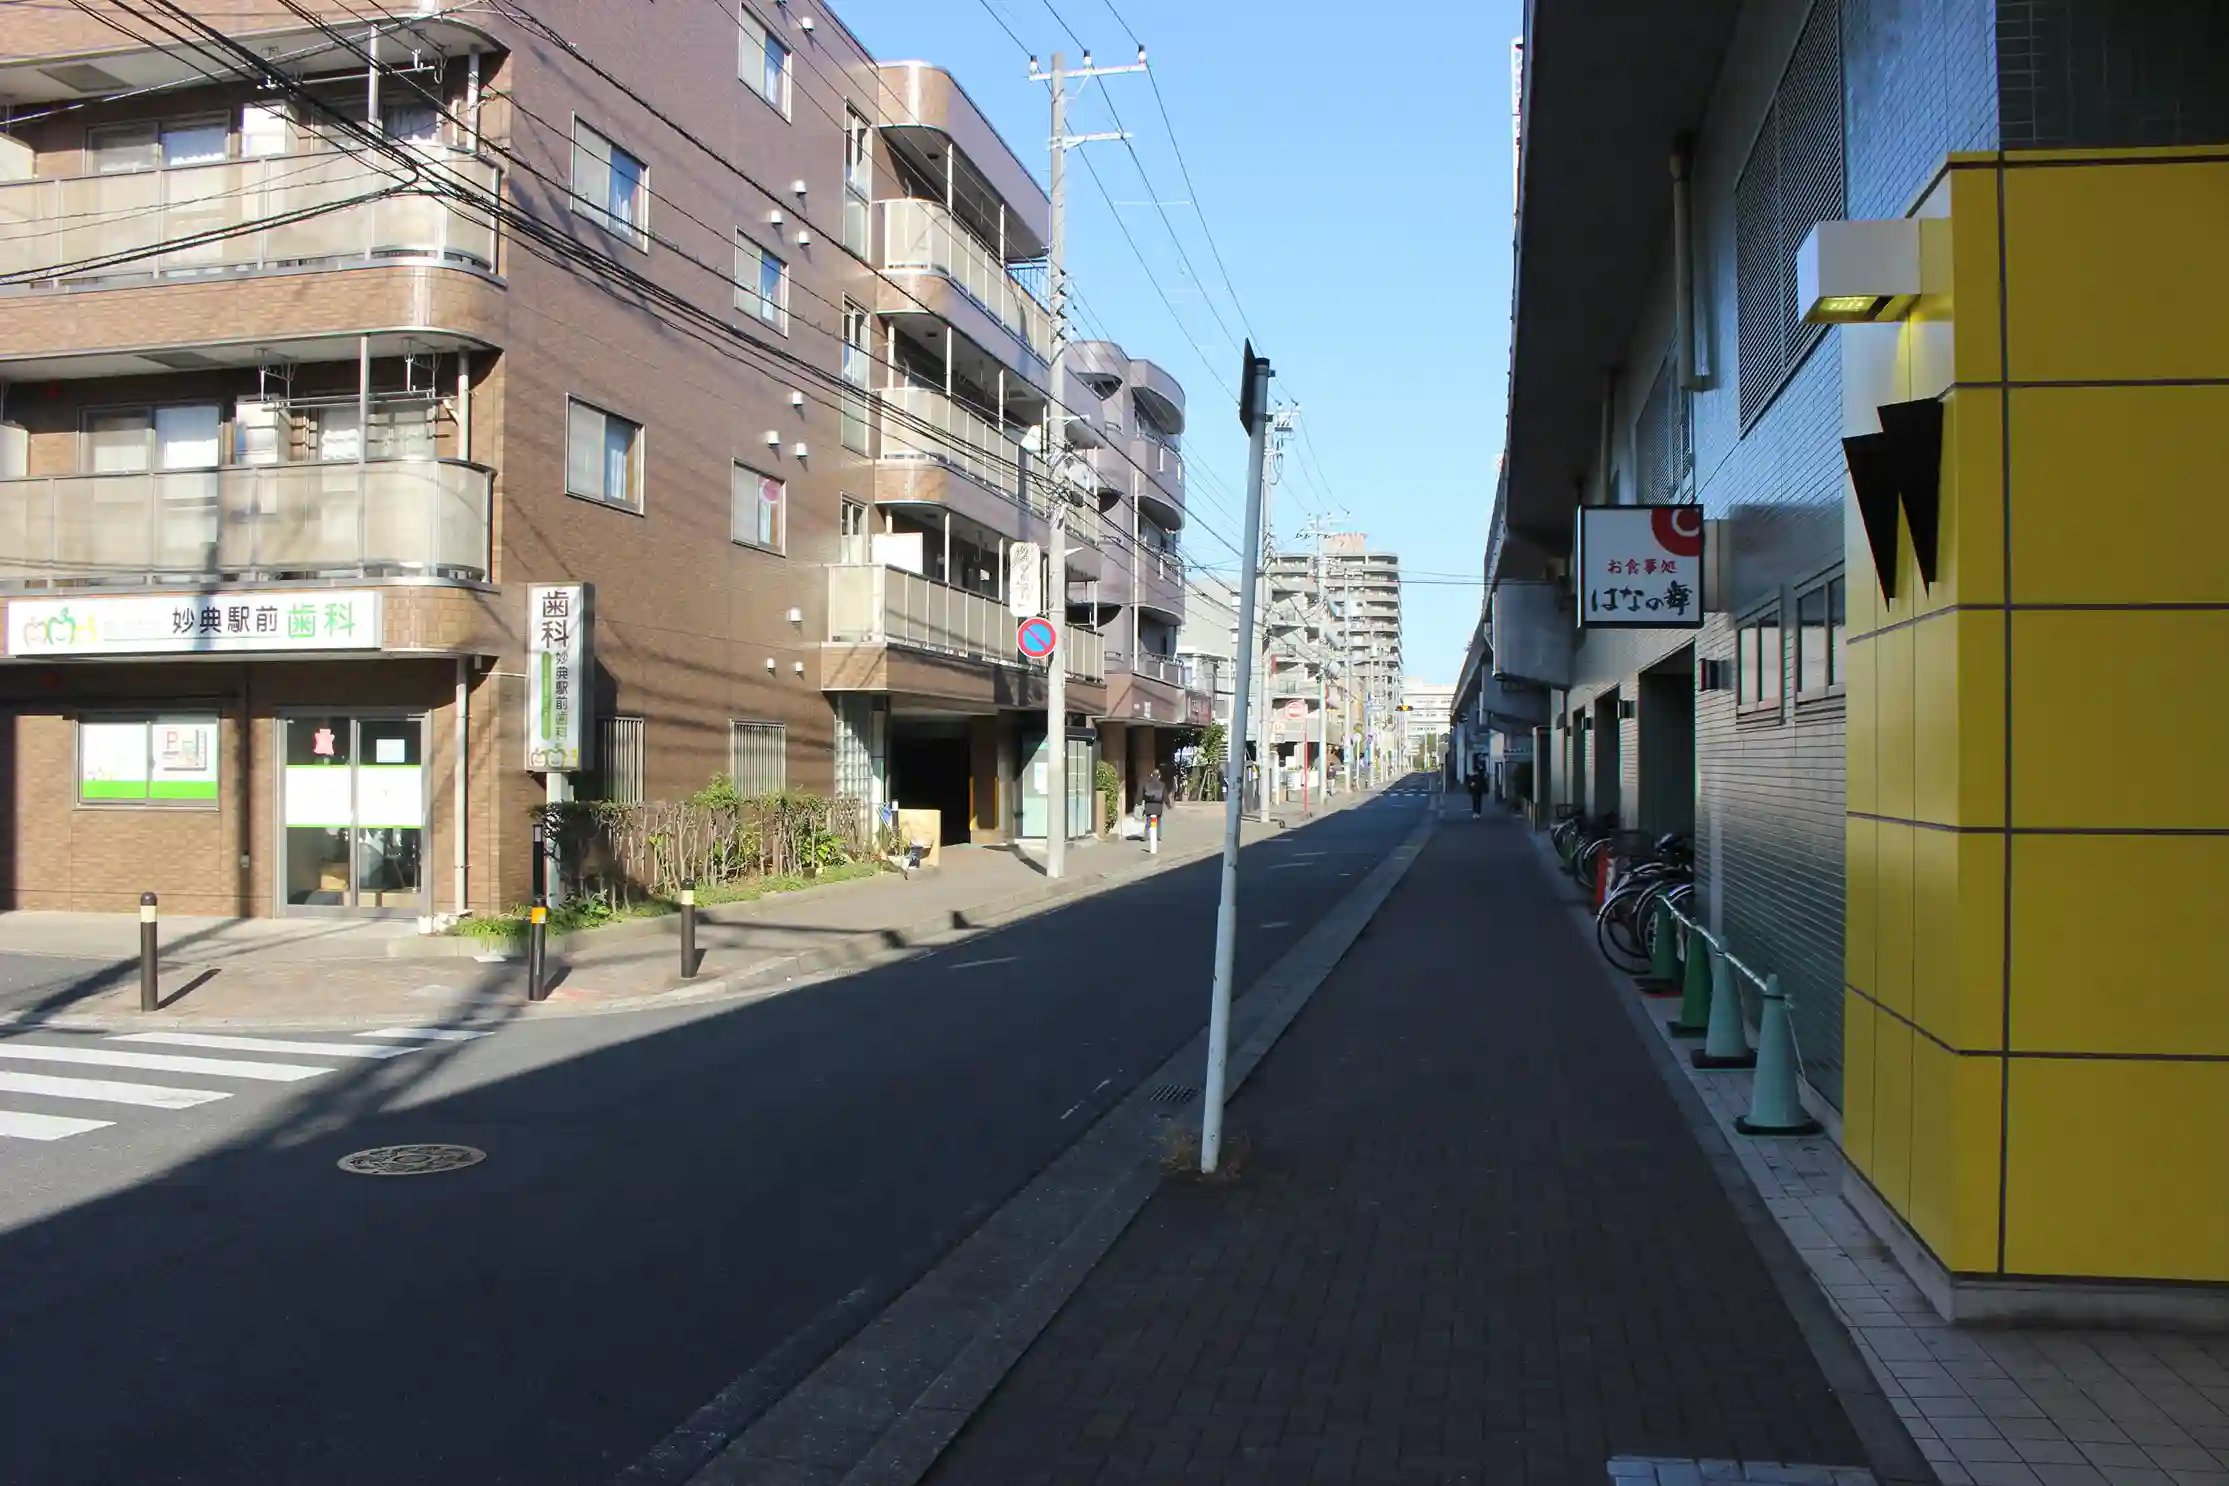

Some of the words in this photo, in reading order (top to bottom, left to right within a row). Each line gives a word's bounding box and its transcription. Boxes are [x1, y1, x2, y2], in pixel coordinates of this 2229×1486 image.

[1607, 559, 1677, 575] お食事処
[171, 602, 356, 639] 妙典駅前歯科
[541, 590, 569, 648] 歯科
